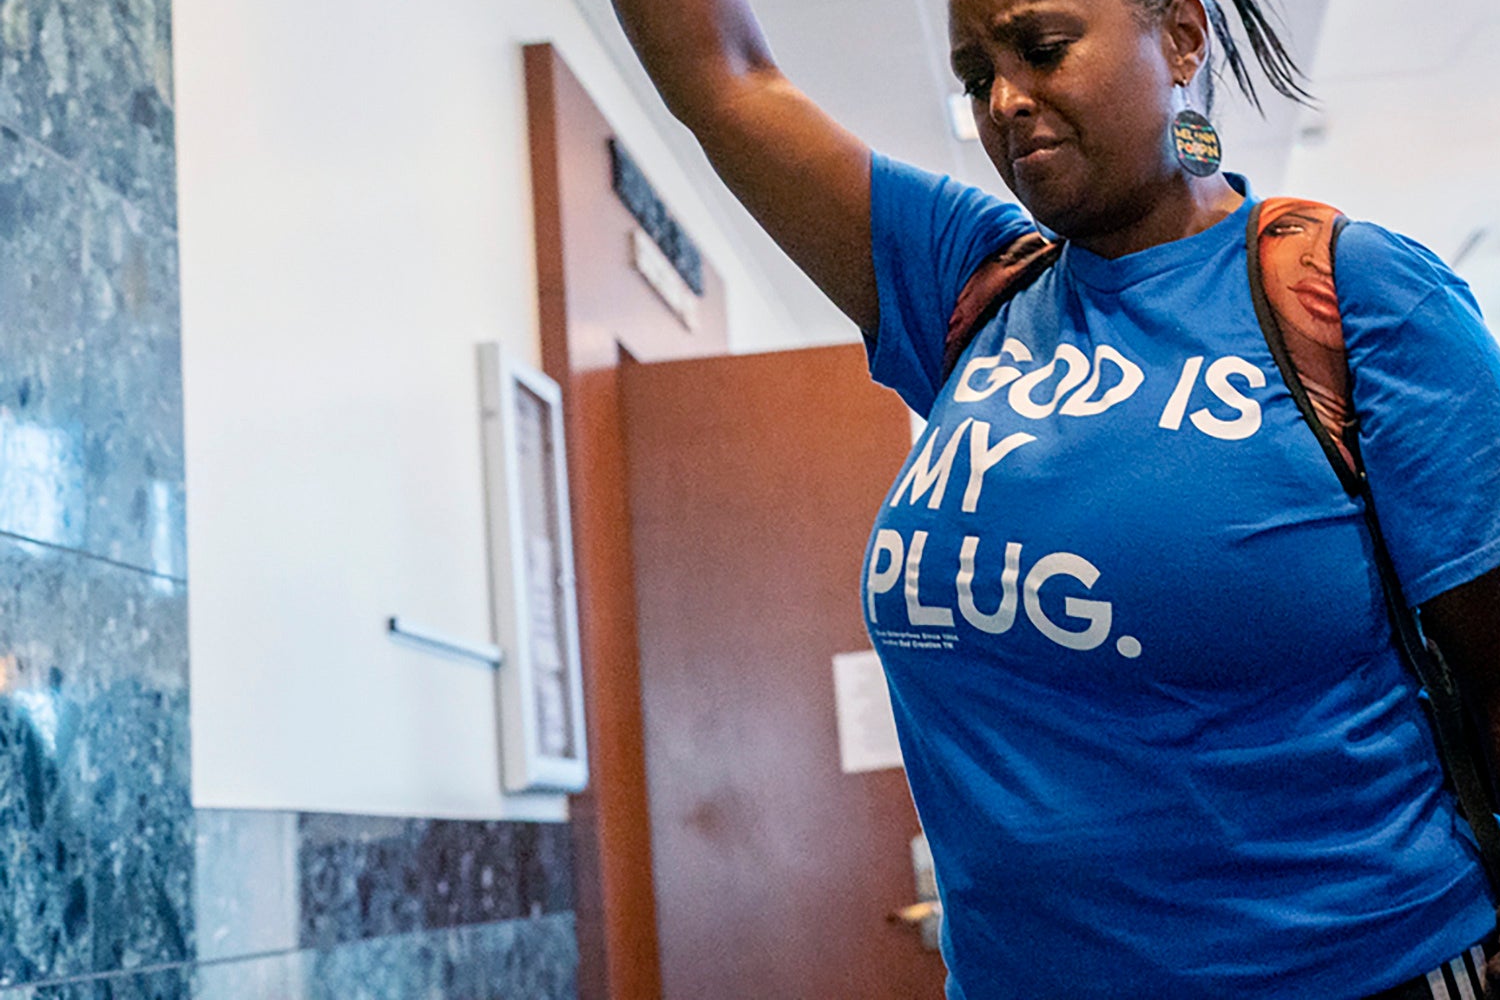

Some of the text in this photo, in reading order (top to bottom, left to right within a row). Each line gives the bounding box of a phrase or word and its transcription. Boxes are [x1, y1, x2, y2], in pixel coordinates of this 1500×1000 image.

[954, 338, 1266, 441] GOD IS
[890, 417, 1037, 513] MY
[867, 529, 1142, 659] PLUG.
